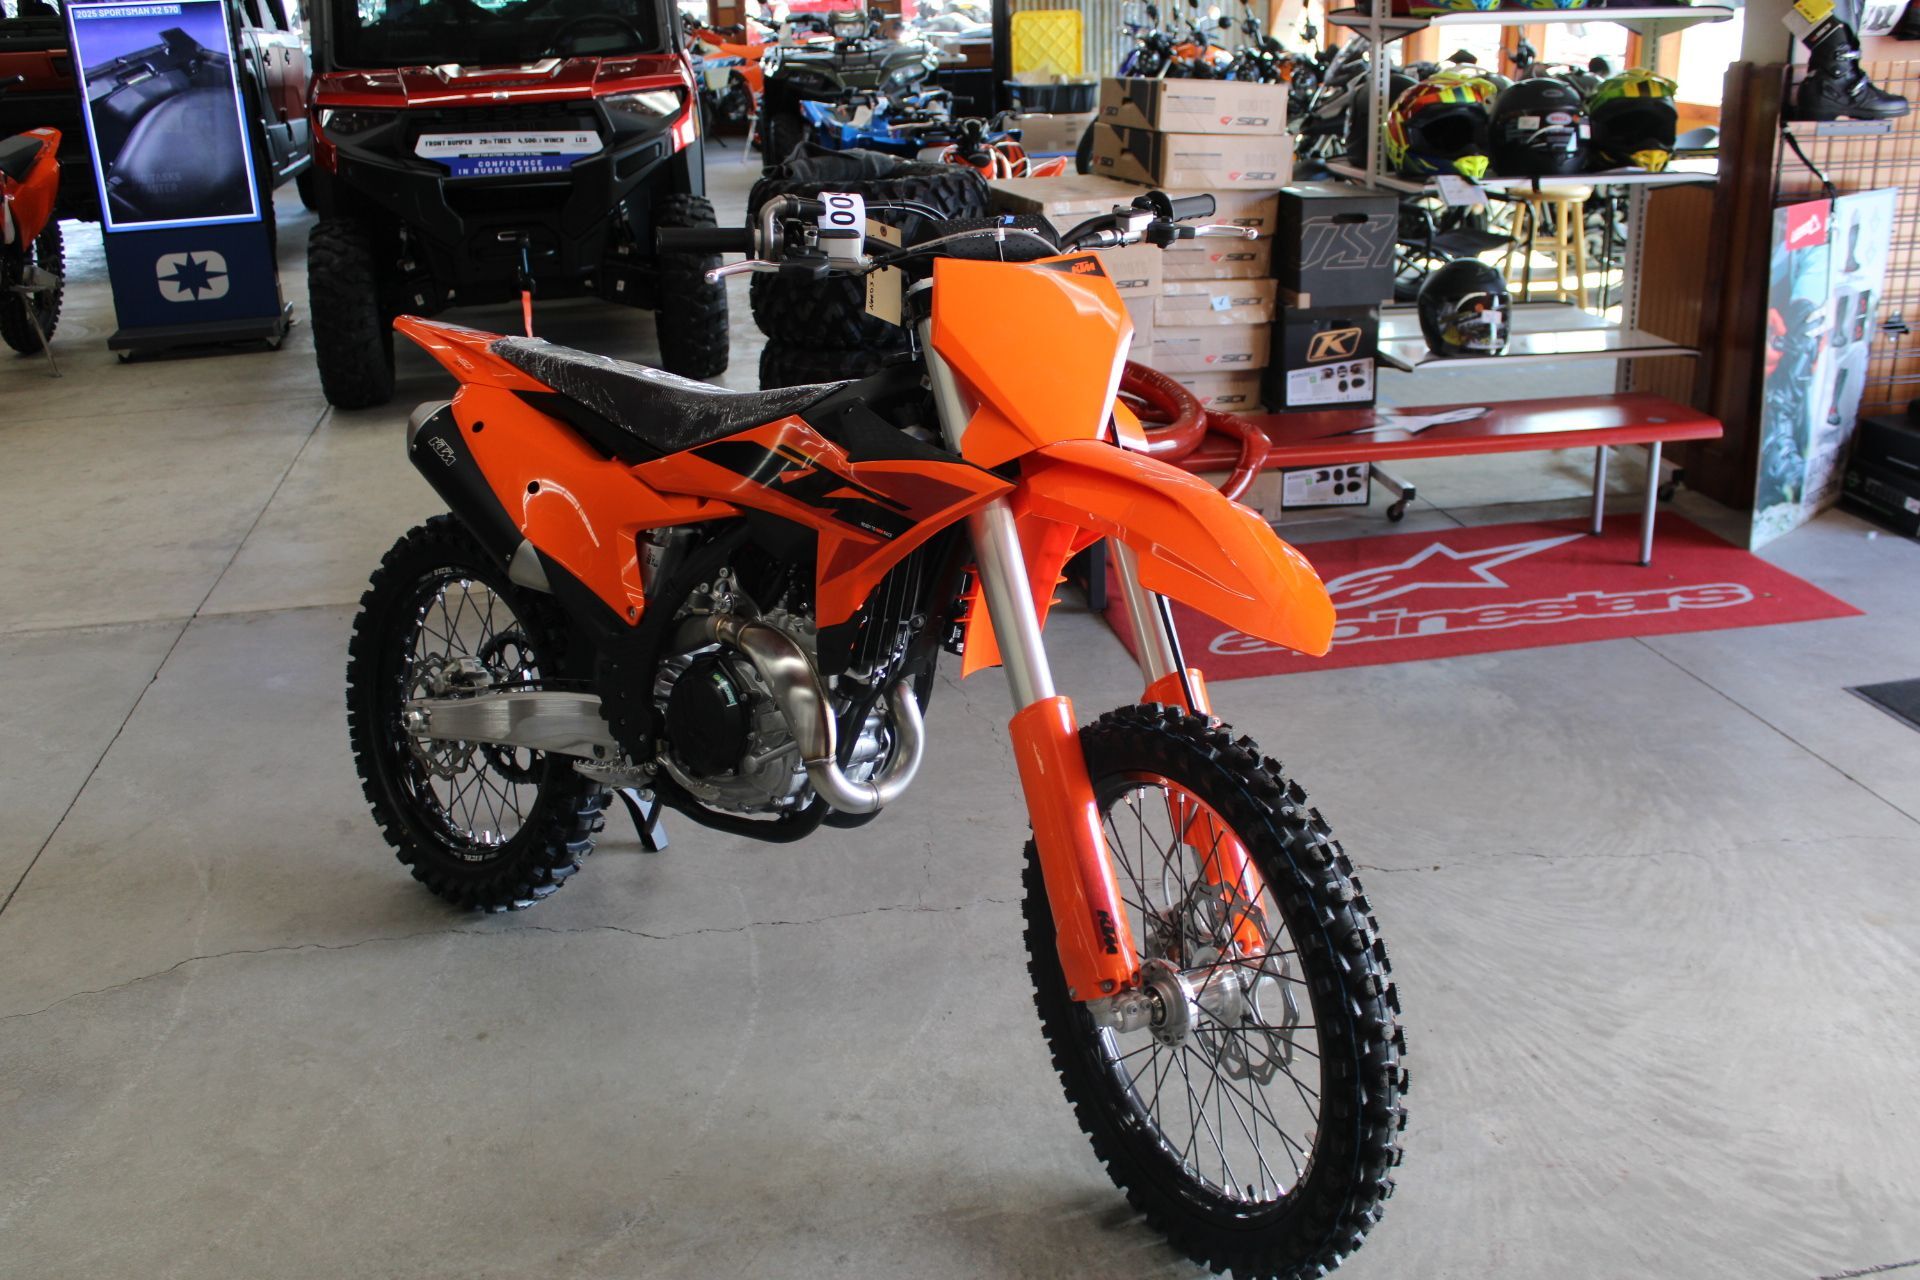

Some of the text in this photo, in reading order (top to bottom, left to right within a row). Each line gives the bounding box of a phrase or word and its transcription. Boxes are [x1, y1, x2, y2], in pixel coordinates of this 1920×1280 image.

[76, 10, 97, 19] 2025
[99, 7, 150, 17] SPORTSMAN
[1235, 116, 1270, 126] SIDI
[478, 159, 543, 168] CONFIDENCE
[473, 166, 514, 174] RUGGED
[1243, 171, 1277, 181] SIDI
[1225, 252, 1257, 262] SIDI
[1071, 261, 1097, 275] KTM
[1116, 279, 1150, 289] SIDI
[1220, 353, 1253, 363] SIDI
[428, 437, 457, 467] KTM
[1208, 583, 1754, 656] apinestars
[1096, 909, 1119, 955] KTM
